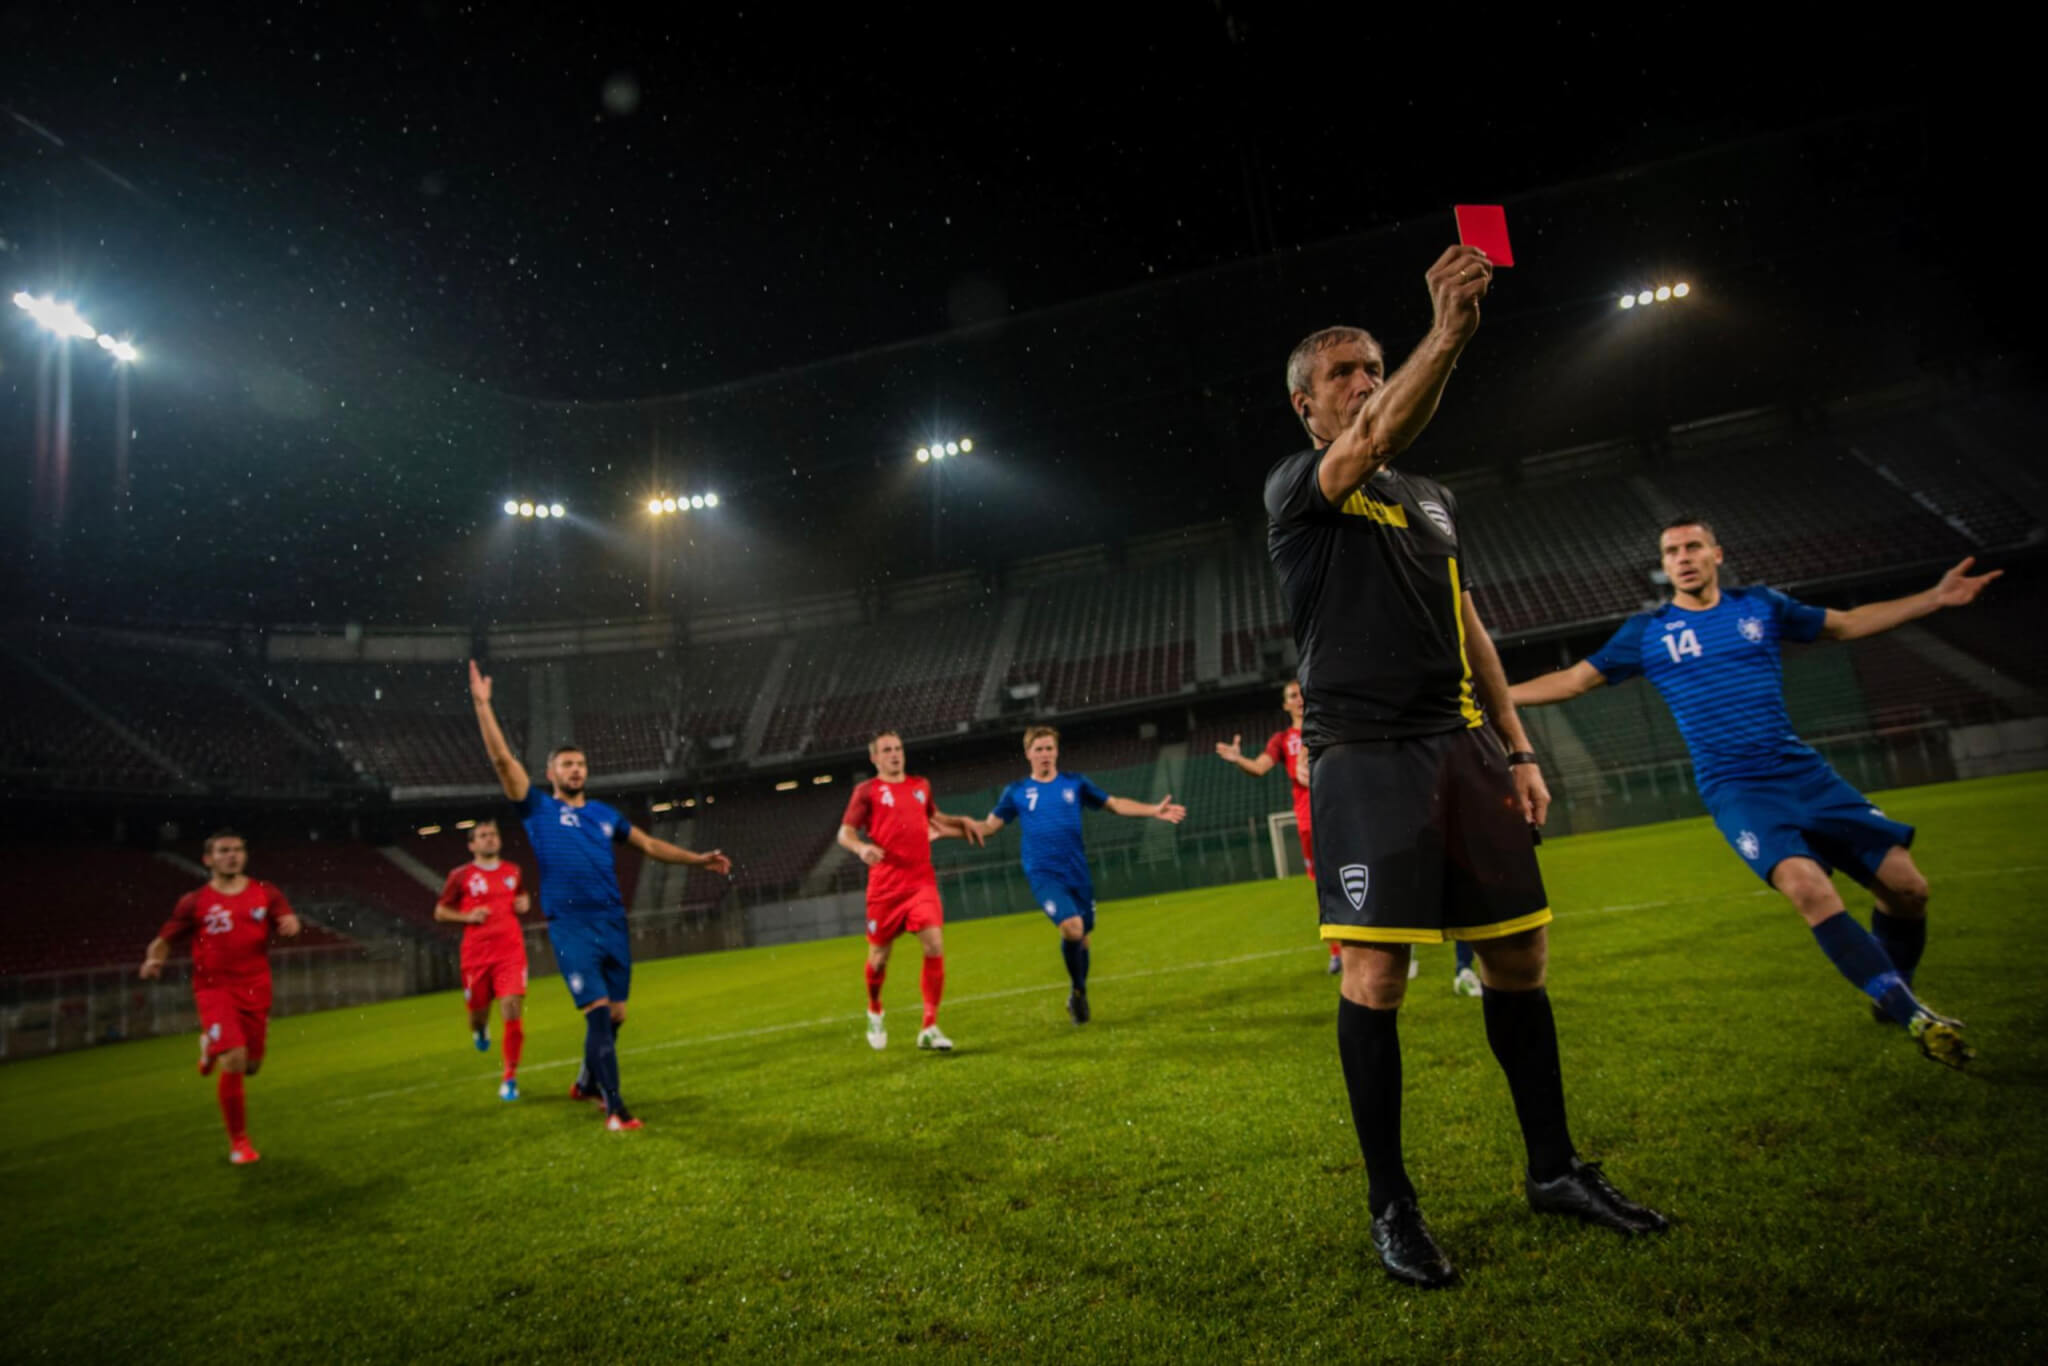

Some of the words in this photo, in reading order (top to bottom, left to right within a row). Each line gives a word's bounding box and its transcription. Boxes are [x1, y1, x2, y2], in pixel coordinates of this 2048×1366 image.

[1661, 629, 1702, 663] 14
[881, 790, 896, 808] 4
[1025, 792, 1039, 812] 7
[204, 910, 233, 935] 23
